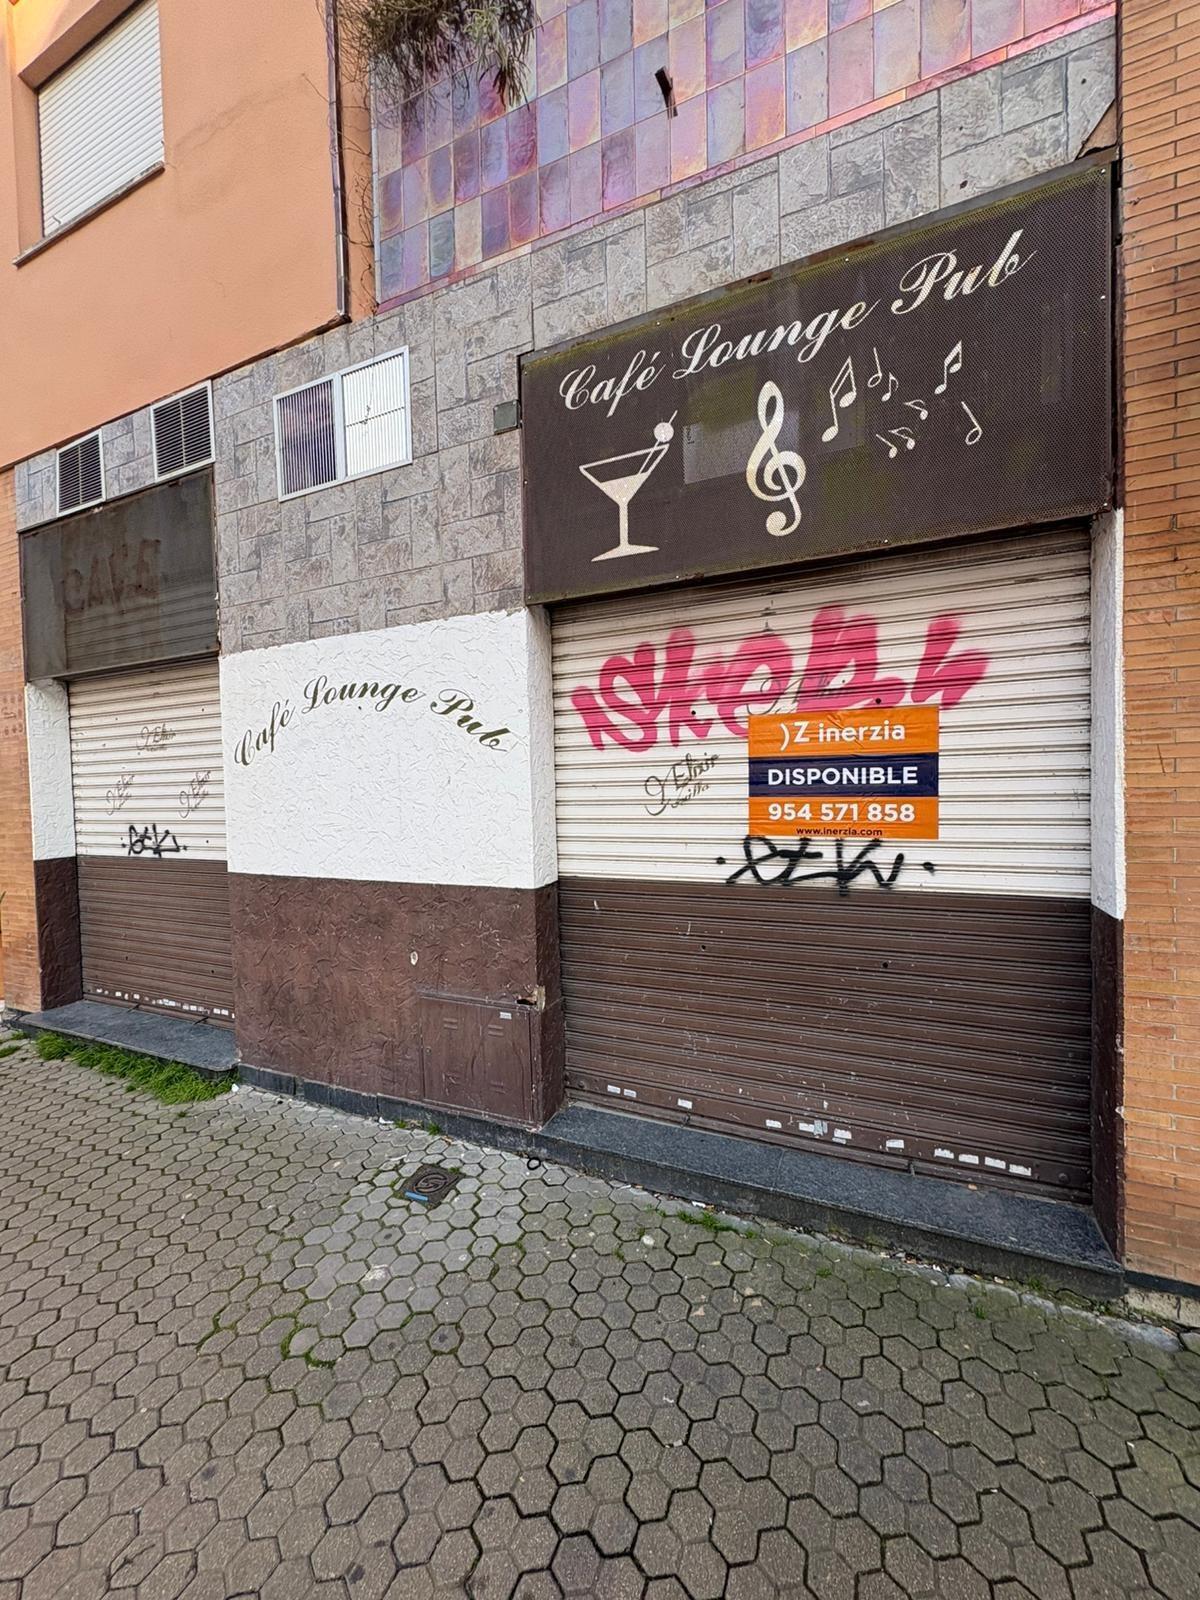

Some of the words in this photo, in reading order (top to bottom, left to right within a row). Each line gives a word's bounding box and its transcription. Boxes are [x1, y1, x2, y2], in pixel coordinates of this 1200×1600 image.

[559, 349, 665, 416] Café
[672, 299, 882, 379] Lounge
[891, 229, 1036, 315] Pub
[234, 699, 296, 766] Café
[301, 675, 426, 714] Lounge
[430, 688, 512, 752] Pub
[818, 720, 905, 742] inerzia
[768, 767, 918, 785] DISPONIBLE
[768, 803, 812, 821] 954
[820, 803, 858, 821] 571
[867, 803, 915, 822] 858
[796, 827, 883, 836] www.inerzia.com
